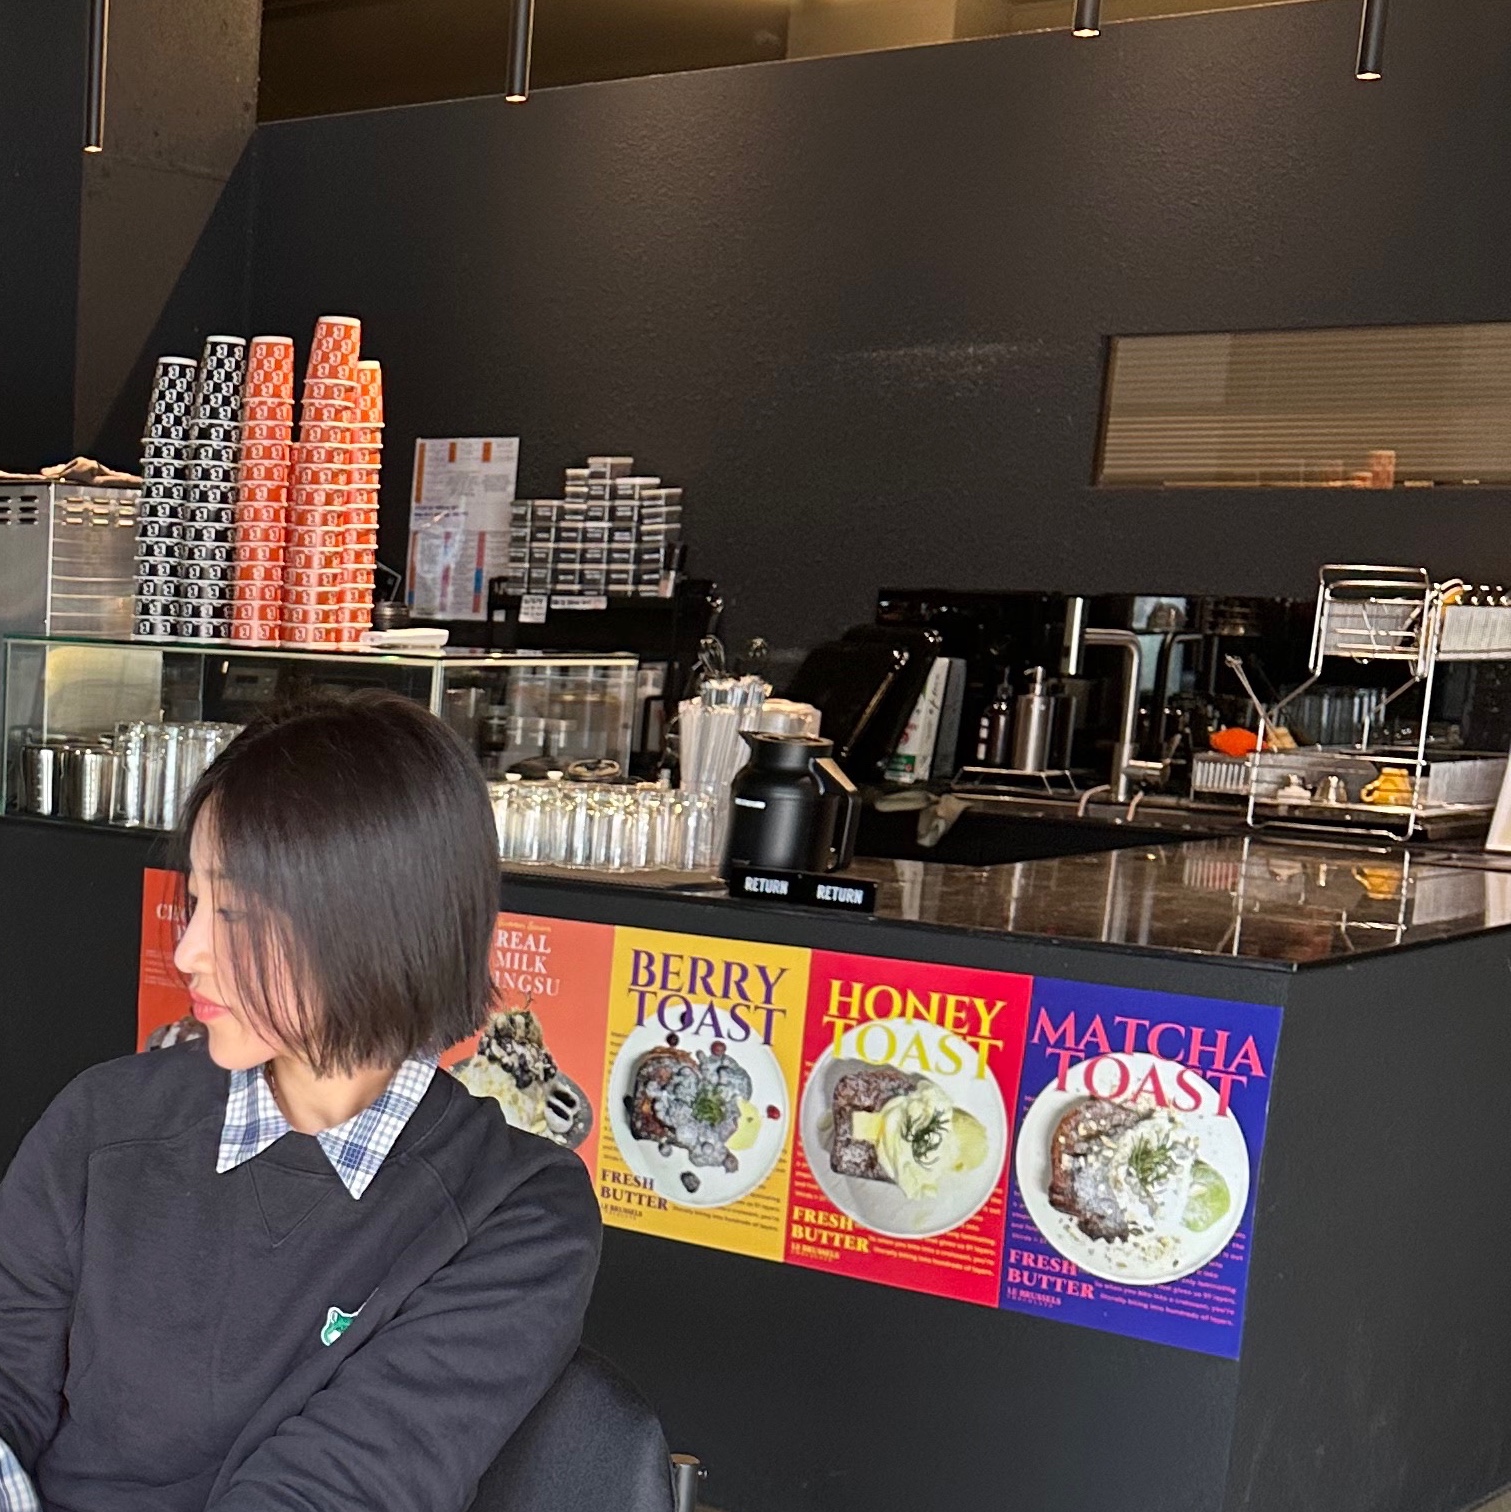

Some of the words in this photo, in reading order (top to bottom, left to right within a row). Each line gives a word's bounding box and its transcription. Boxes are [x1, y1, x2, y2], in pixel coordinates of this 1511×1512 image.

[744, 876, 789, 896] RETURN
[816, 884, 864, 906] RETURN
[495, 929, 552, 954] REAL
[495, 949, 548, 974] MILK
[630, 948, 790, 1005] BERRY
[495, 970, 561, 997] INGSU
[627, 987, 788, 1047] TOAST
[827, 978, 1008, 1038] HONEY
[822, 1014, 1004, 1080] TOAST
[1030, 1005, 1268, 1078] MATCHA
[1045, 1046, 1248, 1118] TOAST
[601, 1167, 656, 1191] FRESH
[600, 1184, 669, 1211] BUTTER
[792, 1204, 854, 1232] FRESH
[790, 1223, 870, 1254] BUTTER
[1009, 1247, 1078, 1277] FRESH
[1006, 1266, 1096, 1300] BUTTER
